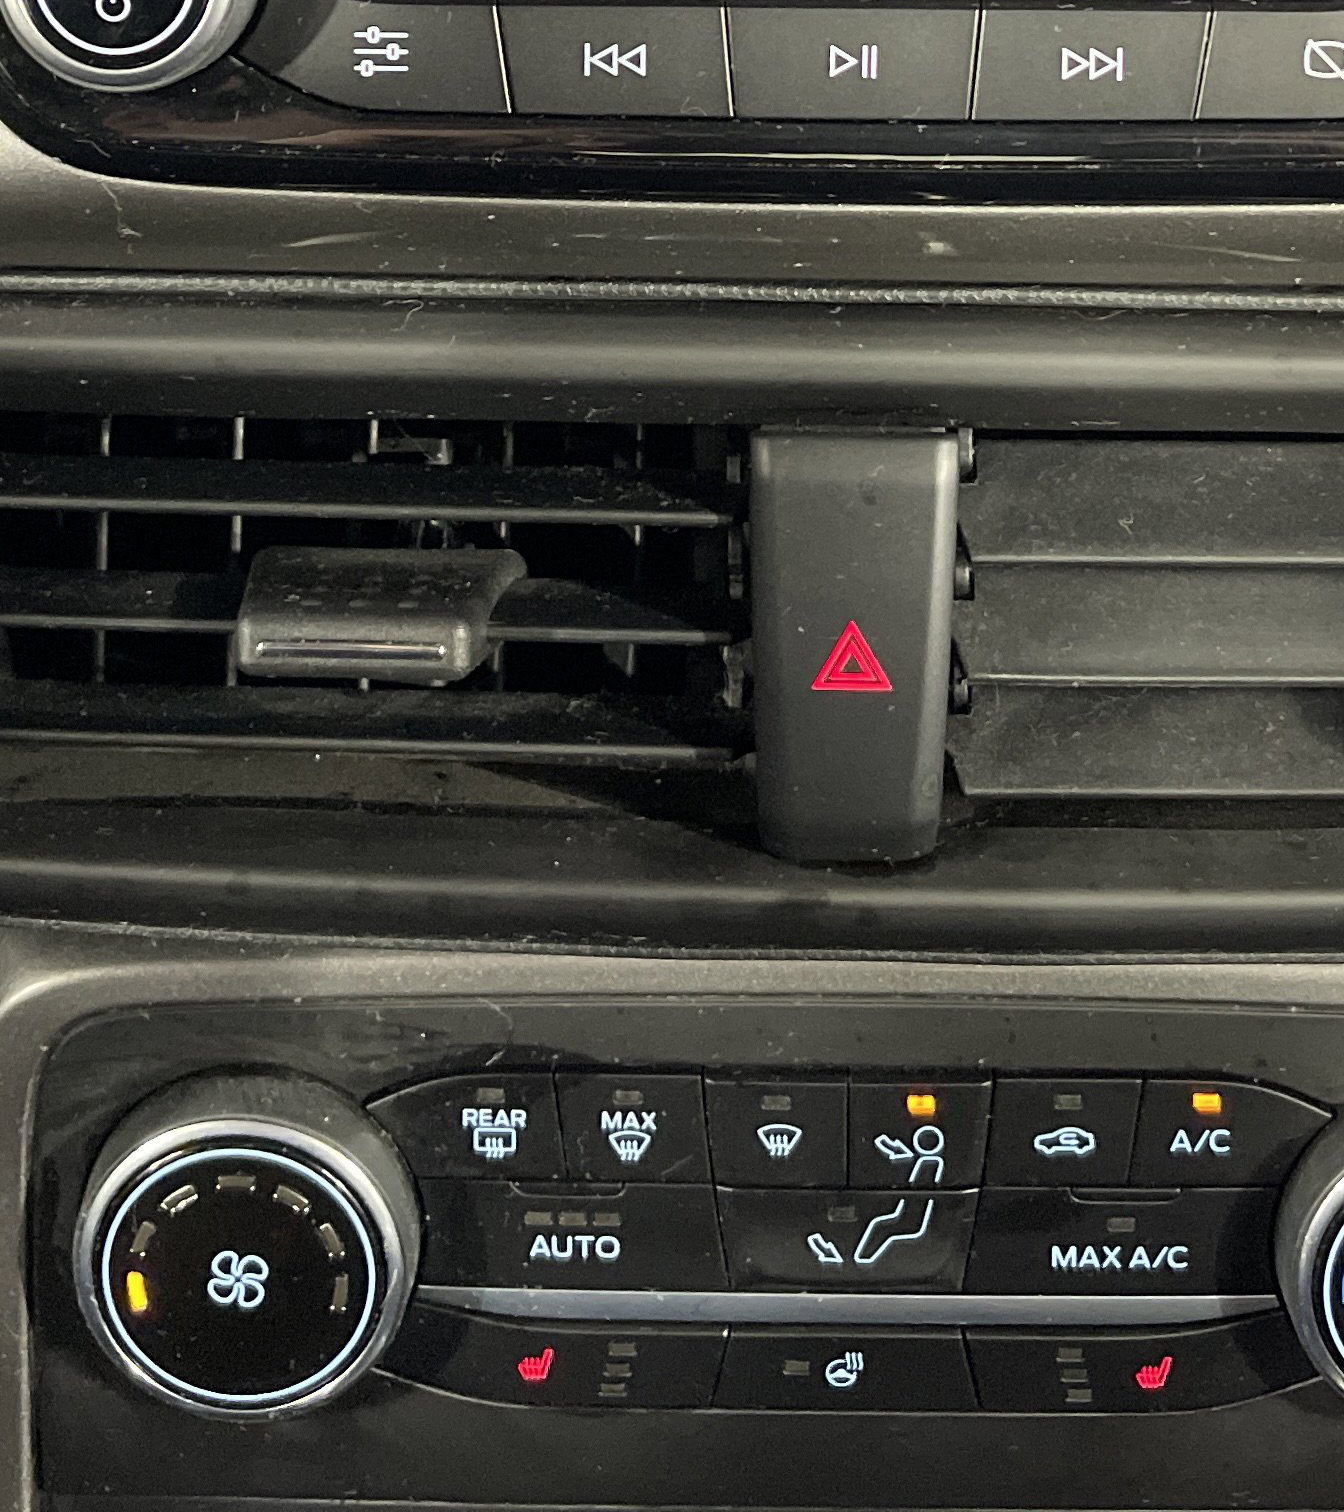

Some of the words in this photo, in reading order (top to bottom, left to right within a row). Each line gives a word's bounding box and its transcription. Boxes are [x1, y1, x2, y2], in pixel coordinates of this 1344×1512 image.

[461, 1108, 528, 1129] REAR
[600, 1111, 657, 1131] MAX
[1169, 1129, 1232, 1154] A/C
[529, 1234, 621, 1260] AUTO
[1050, 1245, 1122, 1270] MAX
[1128, 1245, 1189, 1270] A/C
